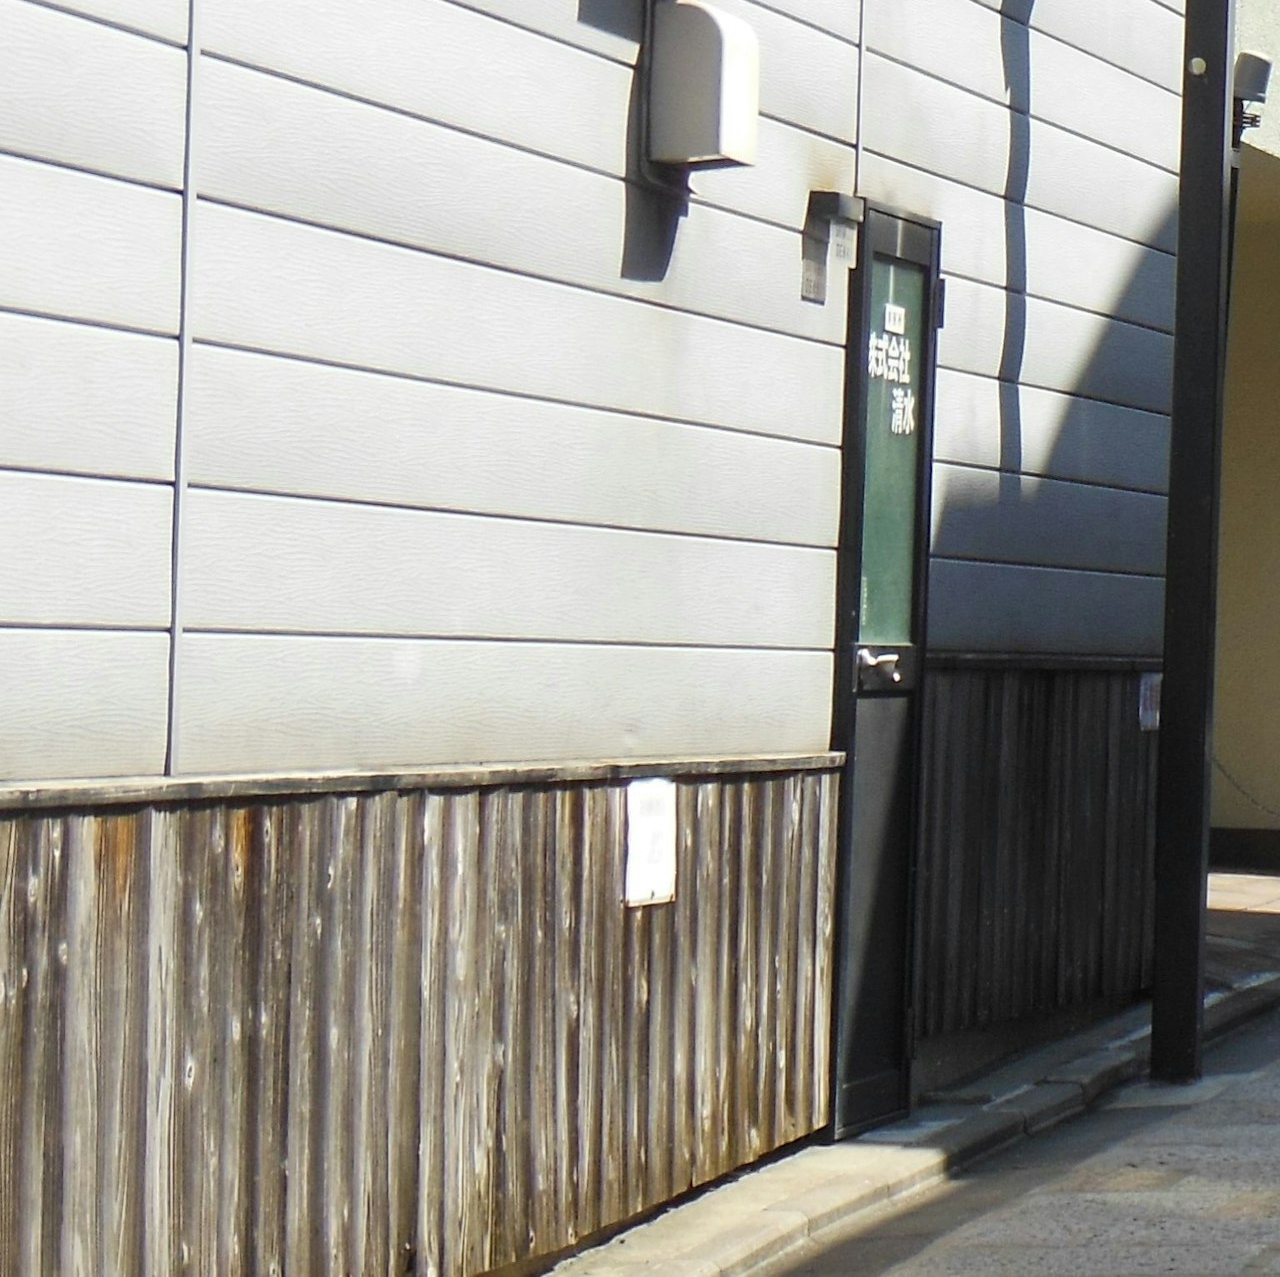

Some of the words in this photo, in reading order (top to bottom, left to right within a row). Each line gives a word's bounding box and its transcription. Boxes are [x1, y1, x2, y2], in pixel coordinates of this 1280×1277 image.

[868, 331, 911, 384] 株式会社
[891, 387, 915, 435] 清水
